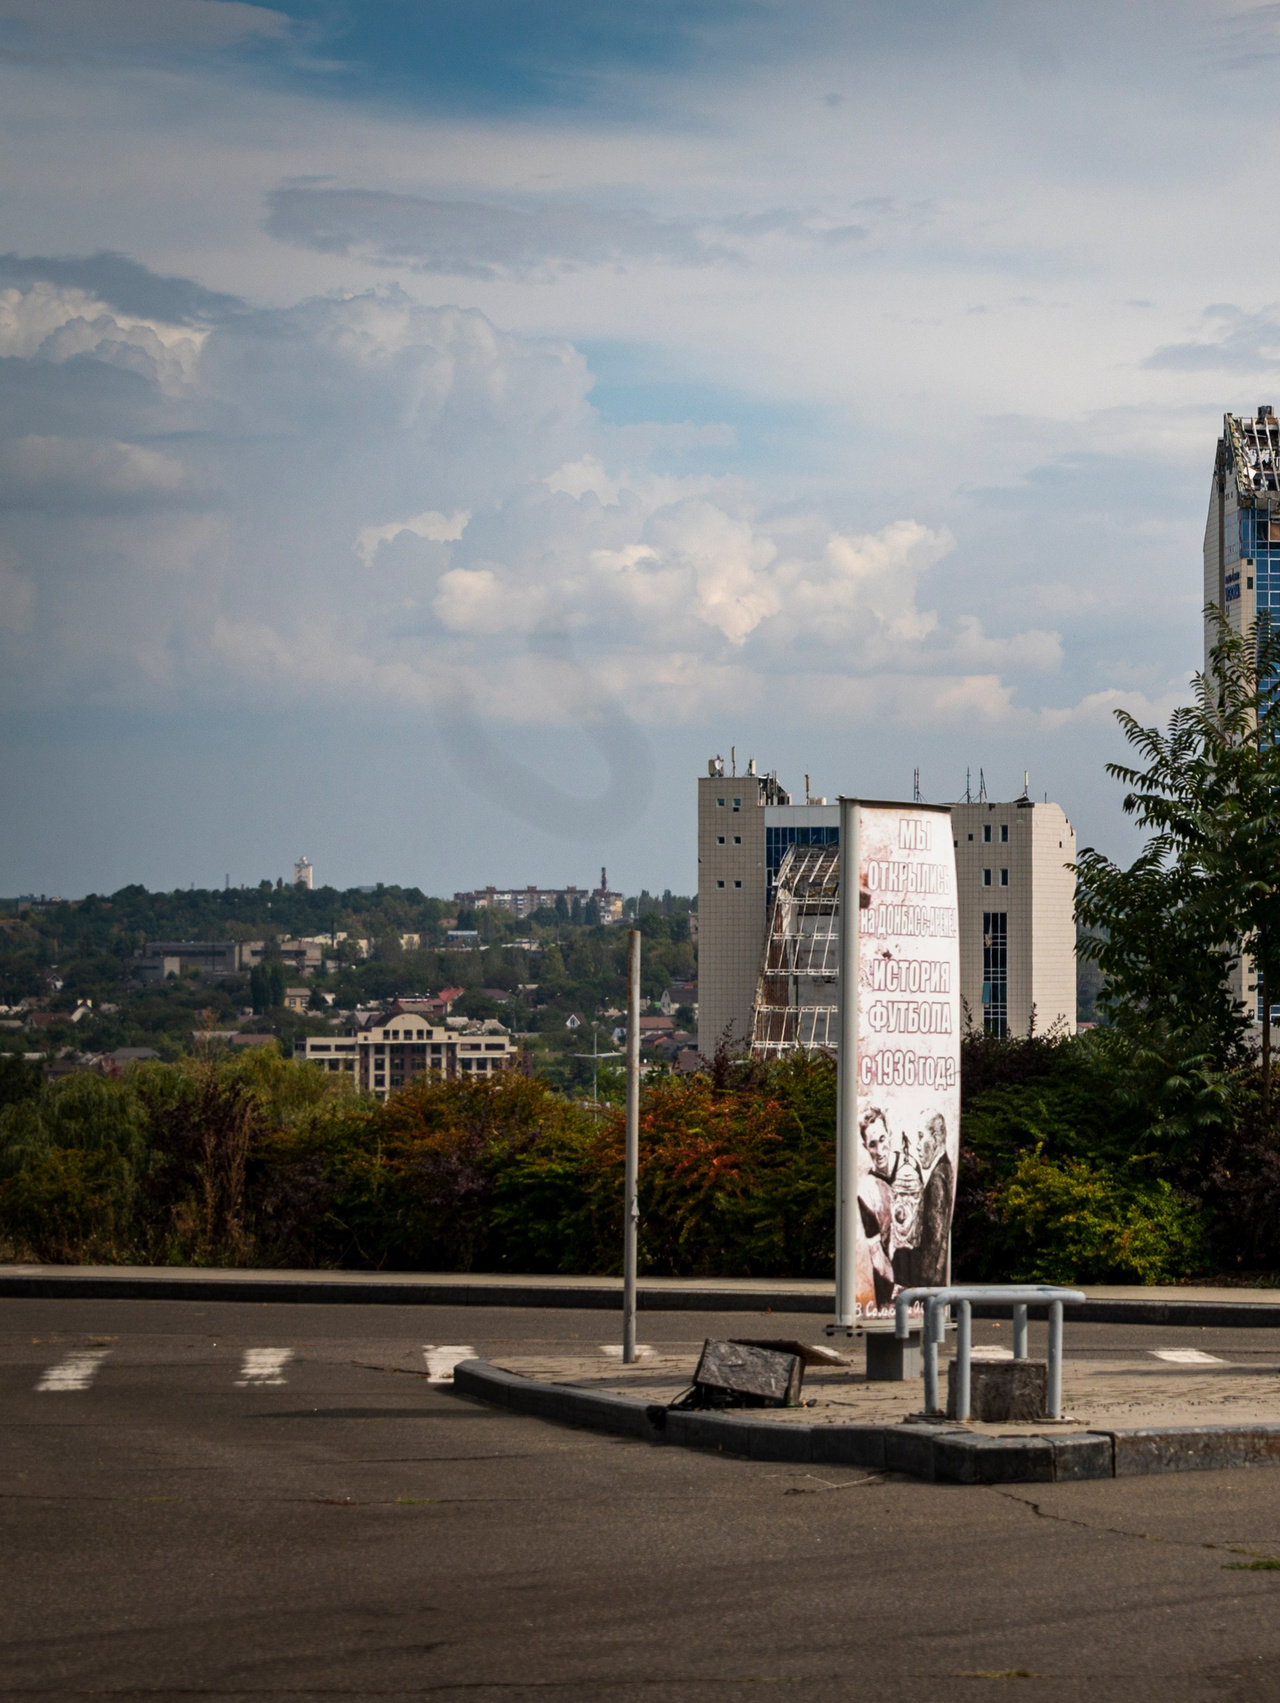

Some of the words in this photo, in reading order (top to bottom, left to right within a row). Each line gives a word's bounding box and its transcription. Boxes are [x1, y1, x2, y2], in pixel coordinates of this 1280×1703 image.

[899, 819, 932, 851] МЫ
[867, 860, 951, 895] ОТКРЫЛИСЬ
[860, 908, 876, 935] на
[872, 959, 950, 993] ИСТОРИЯ
[868, 1000, 952, 1034] ФУТБОЛА
[874, 1049, 917, 1086] 1936
[917, 1056, 956, 1091] года
